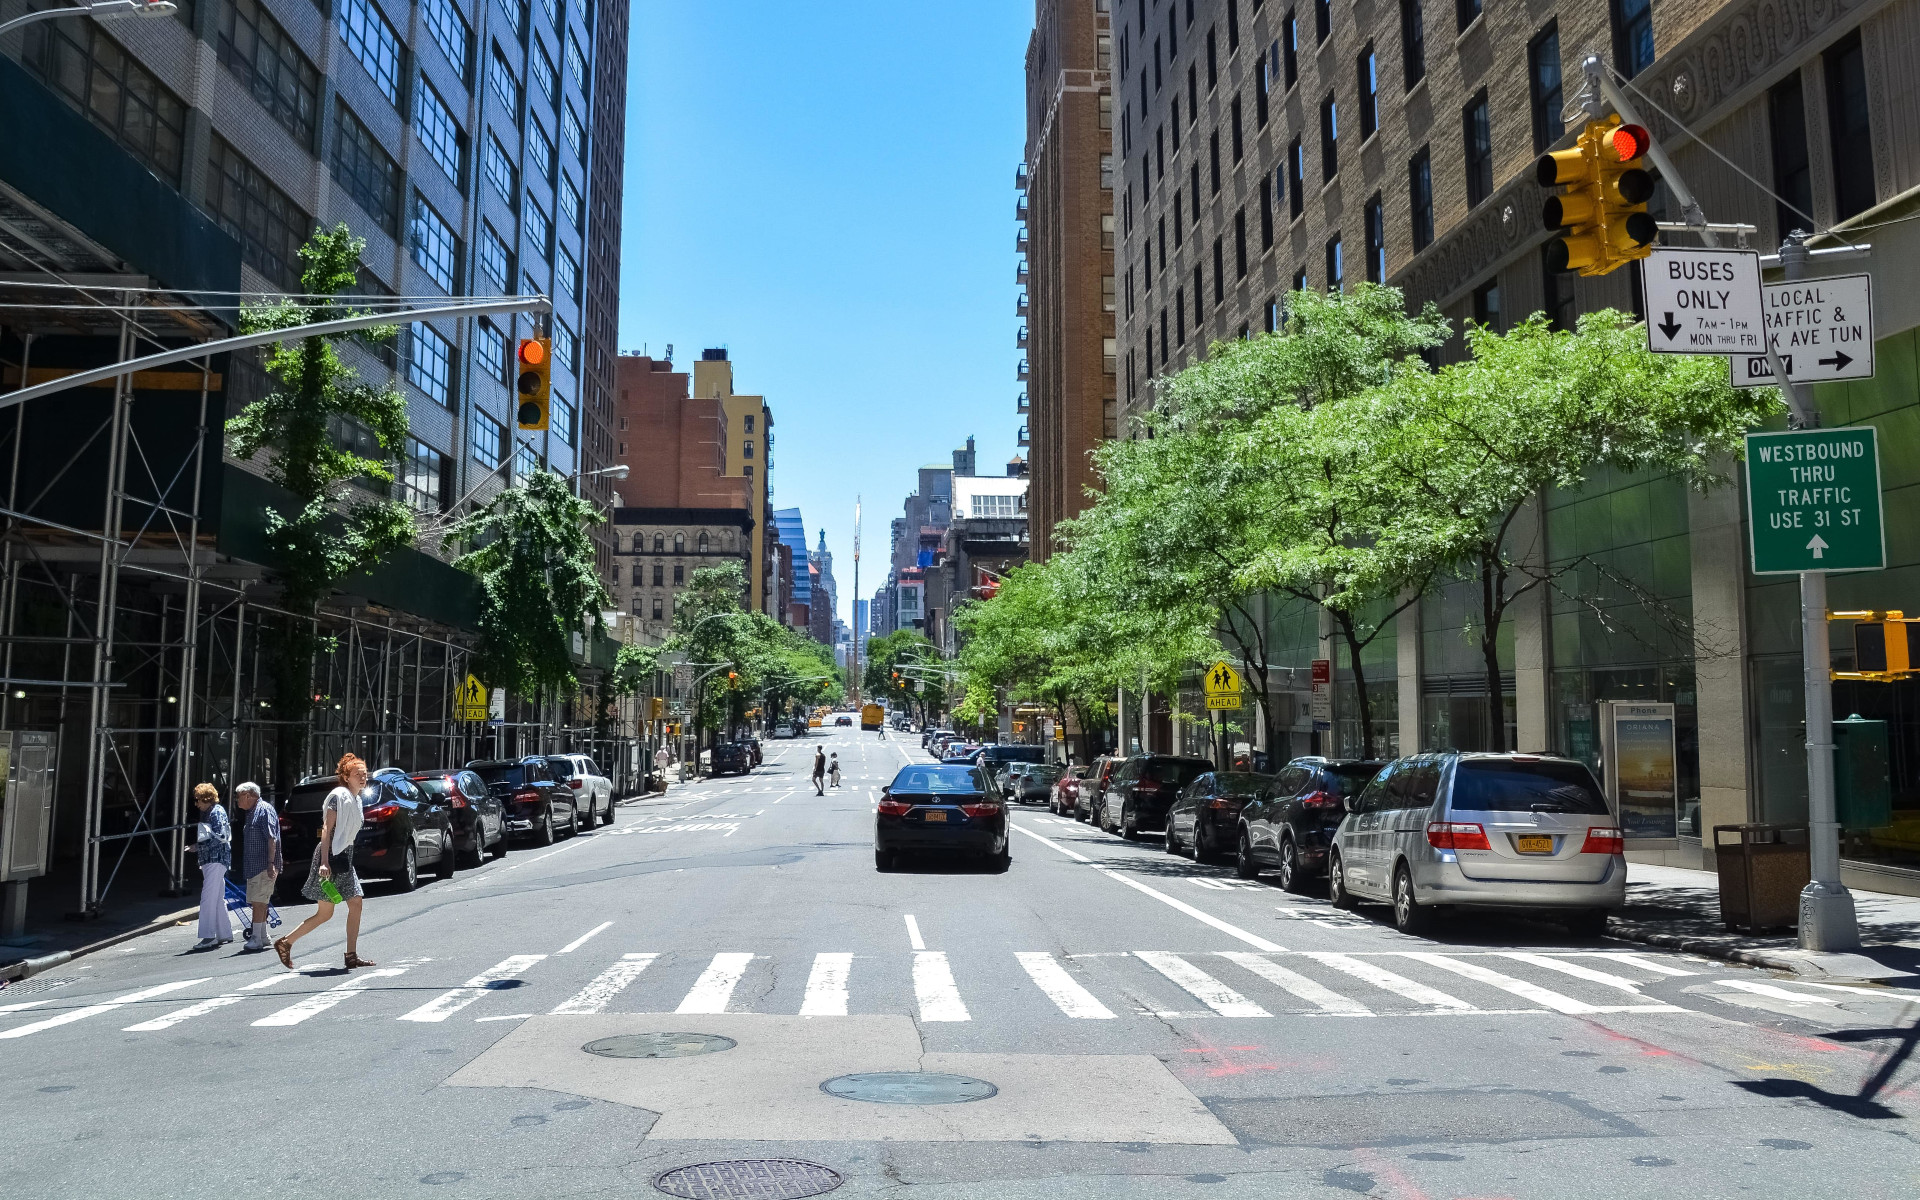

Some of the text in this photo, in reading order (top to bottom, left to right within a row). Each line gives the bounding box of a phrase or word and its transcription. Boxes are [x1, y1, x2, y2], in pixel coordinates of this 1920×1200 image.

[1668, 261, 1735, 281] BUSES
[1676, 290, 1730, 310] ONLY
[1770, 288, 1825, 308] LOCAL
[1696, 317, 1717, 330] 7AM
[1729, 318, 1749, 331] 1PM
[1766, 307, 1847, 329] RAFFIC &
[1690, 333, 1713, 346] MON
[1717, 335, 1736, 345] THRU
[1740, 334, 1758, 346] FRI
[1790, 330, 1821, 347] AVE
[1829, 325, 1863, 344] TUN
[1751, 356, 1790, 376] ONY
[1758, 441, 1864, 463] WESTBOUND
[1789, 465, 1835, 484] THRU
[1777, 487, 1851, 506] TRAFFIC
[1769, 508, 1861, 529] USE 31 ST
[1209, 697, 1238, 707] AHEAD
[1626, 723, 1660, 731] ORIANA
